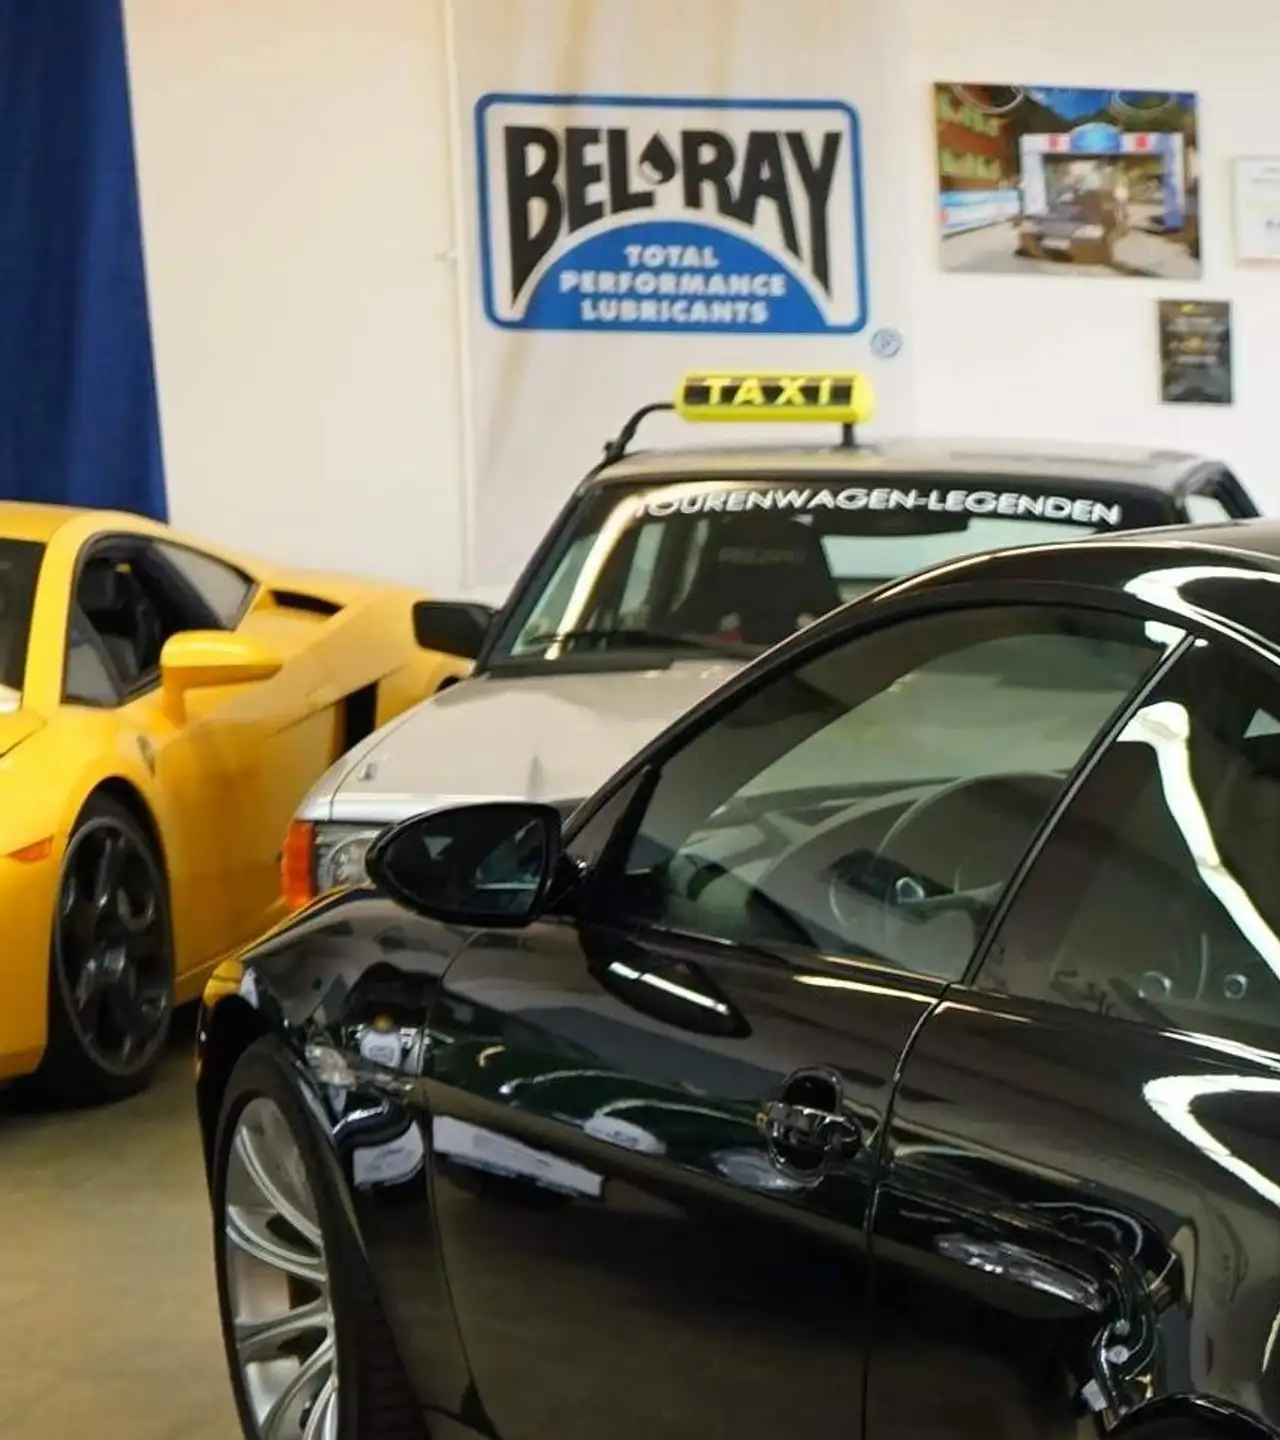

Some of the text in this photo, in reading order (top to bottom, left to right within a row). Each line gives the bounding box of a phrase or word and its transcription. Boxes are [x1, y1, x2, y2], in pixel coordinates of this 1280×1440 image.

[503, 125, 843, 310] BEL RAY
[624, 244, 720, 268] TOTAL
[559, 270, 787, 297] PERFORMANCE
[580, 297, 770, 324] LUBRICANTS
[703, 376, 834, 407] TAXI
